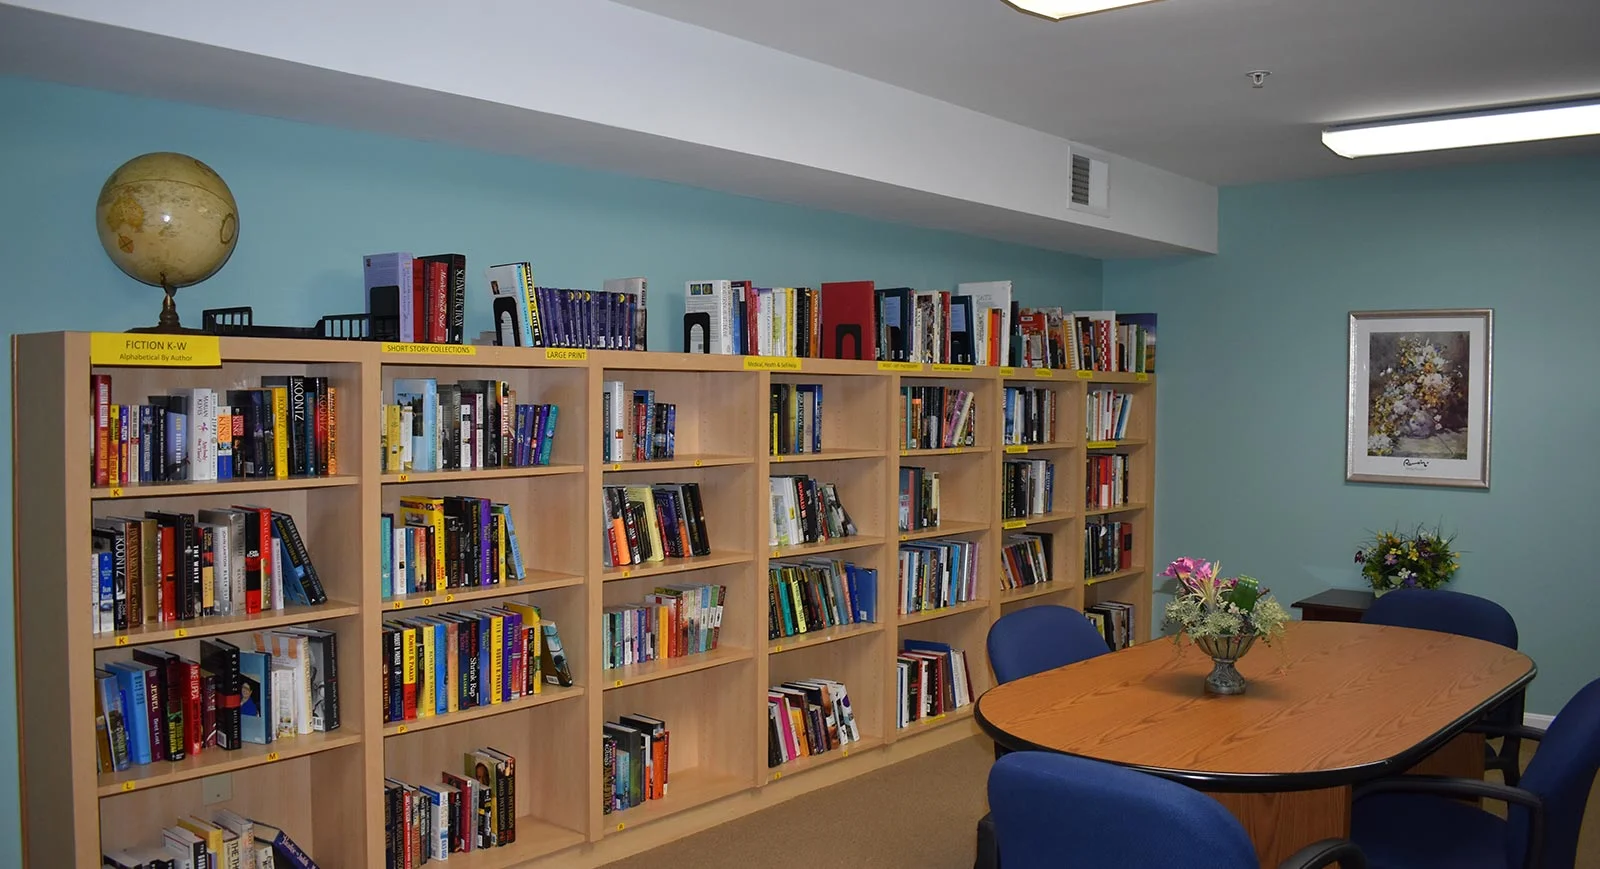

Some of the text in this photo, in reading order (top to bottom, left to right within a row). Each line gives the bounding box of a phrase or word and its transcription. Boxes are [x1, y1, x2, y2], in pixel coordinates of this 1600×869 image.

[455, 298, 463, 326] FICTION
[119, 353, 192, 362] Alphabetical By Author
[126, 340, 187, 351] FICTION K-W
[547, 351, 566, 359] LARGE
[295, 382, 304, 421] KOONTZ
[116, 539, 124, 577] KOONTZ
[190, 666, 199, 700] MIKE LUPICA
[150, 683, 159, 712] JEWEL
[231, 841, 239, 855] THE
